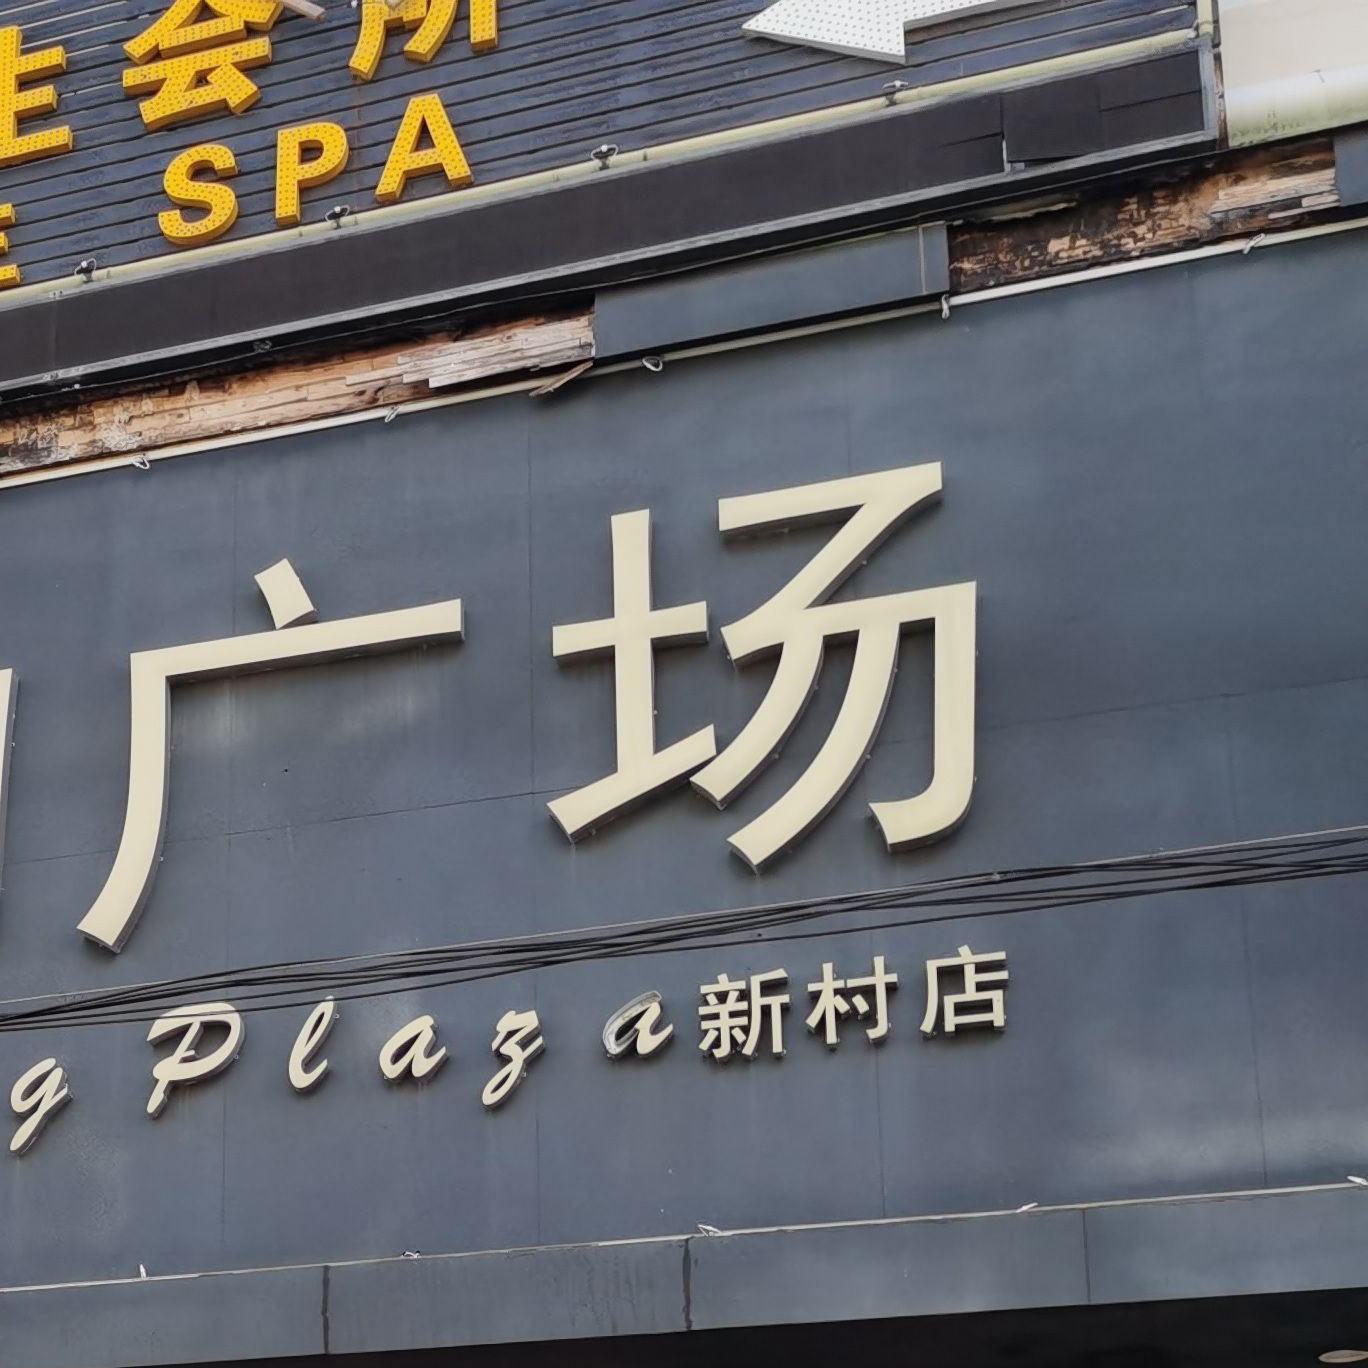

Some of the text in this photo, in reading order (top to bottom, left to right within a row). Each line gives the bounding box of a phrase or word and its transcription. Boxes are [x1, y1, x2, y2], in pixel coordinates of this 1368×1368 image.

[158, 92, 474, 246] SPA
[146, 990, 675, 1117] Plaza
[697, 944, 1010, 1064] 新村店
